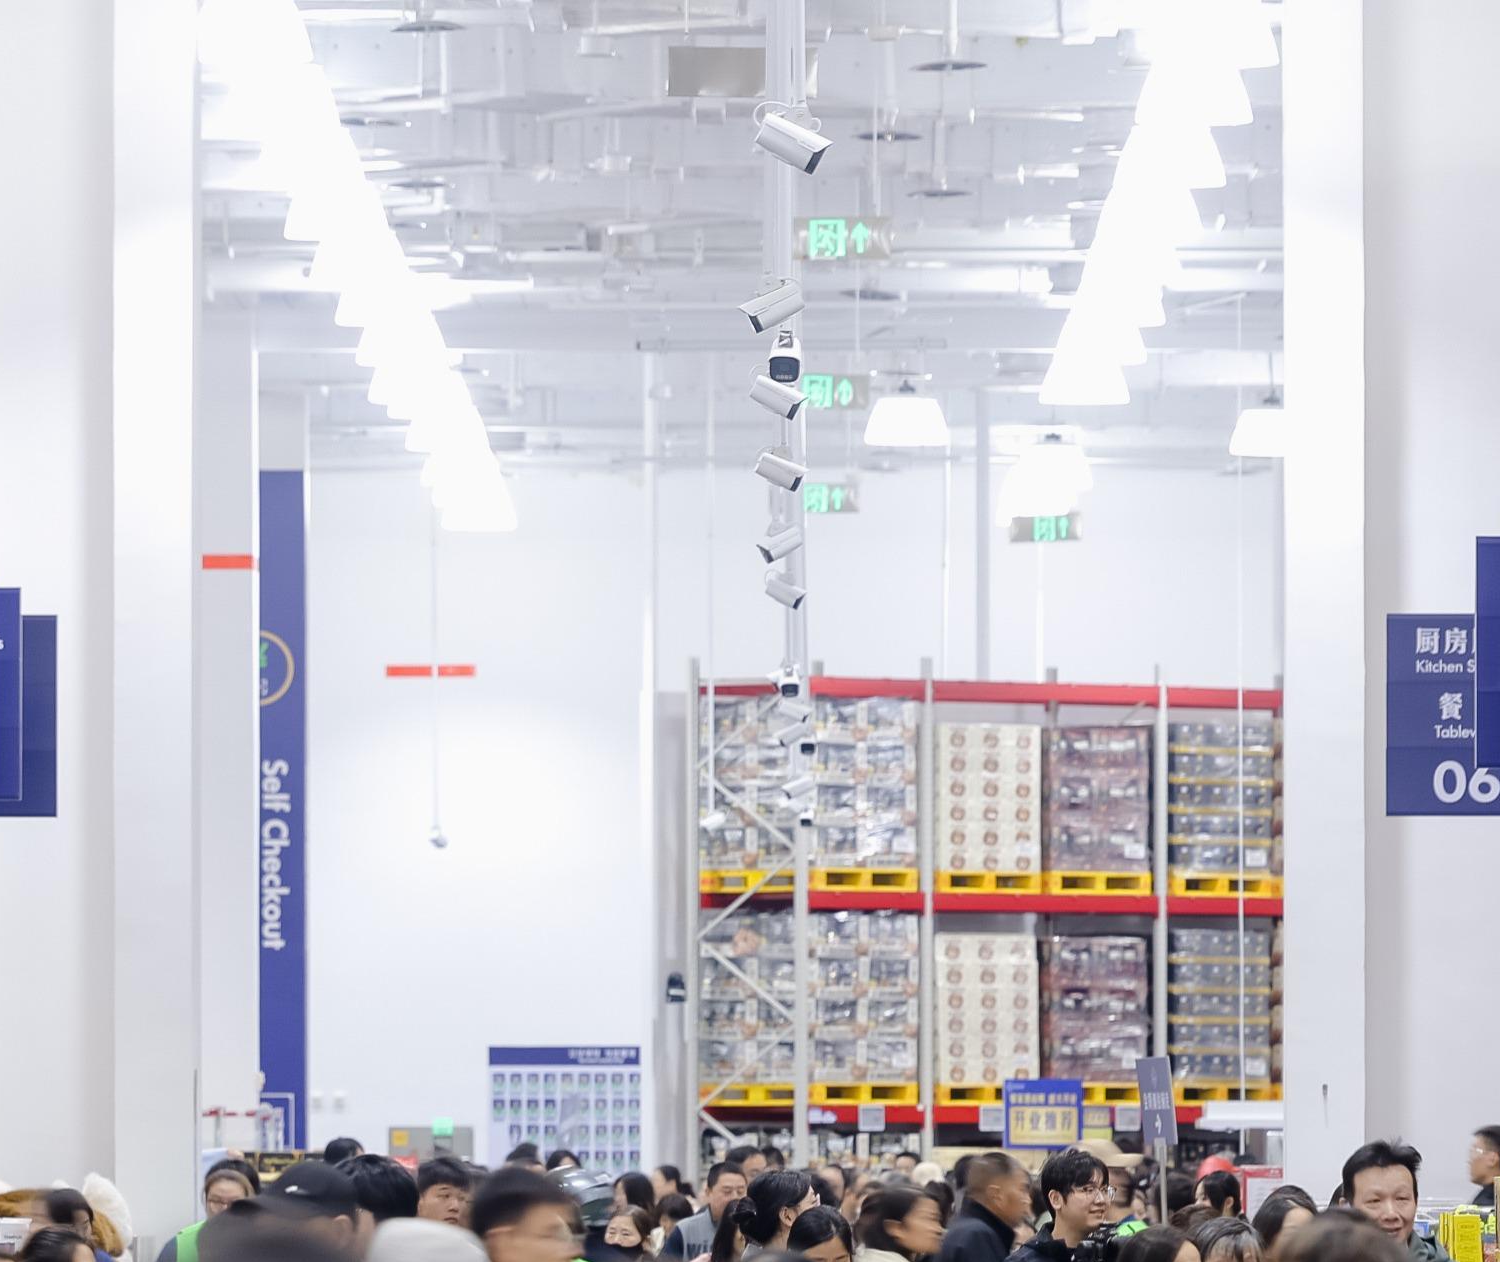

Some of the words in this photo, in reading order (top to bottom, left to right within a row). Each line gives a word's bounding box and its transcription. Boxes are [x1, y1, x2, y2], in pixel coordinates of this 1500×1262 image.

[1415, 627, 1475, 655] 厨房
[1415, 660, 1464, 674] Kitchen
[1439, 692, 1464, 720] 餐
[261, 759, 292, 813] Self
[1433, 760, 1500, 803] 06
[261, 818, 291, 950] Checkout
